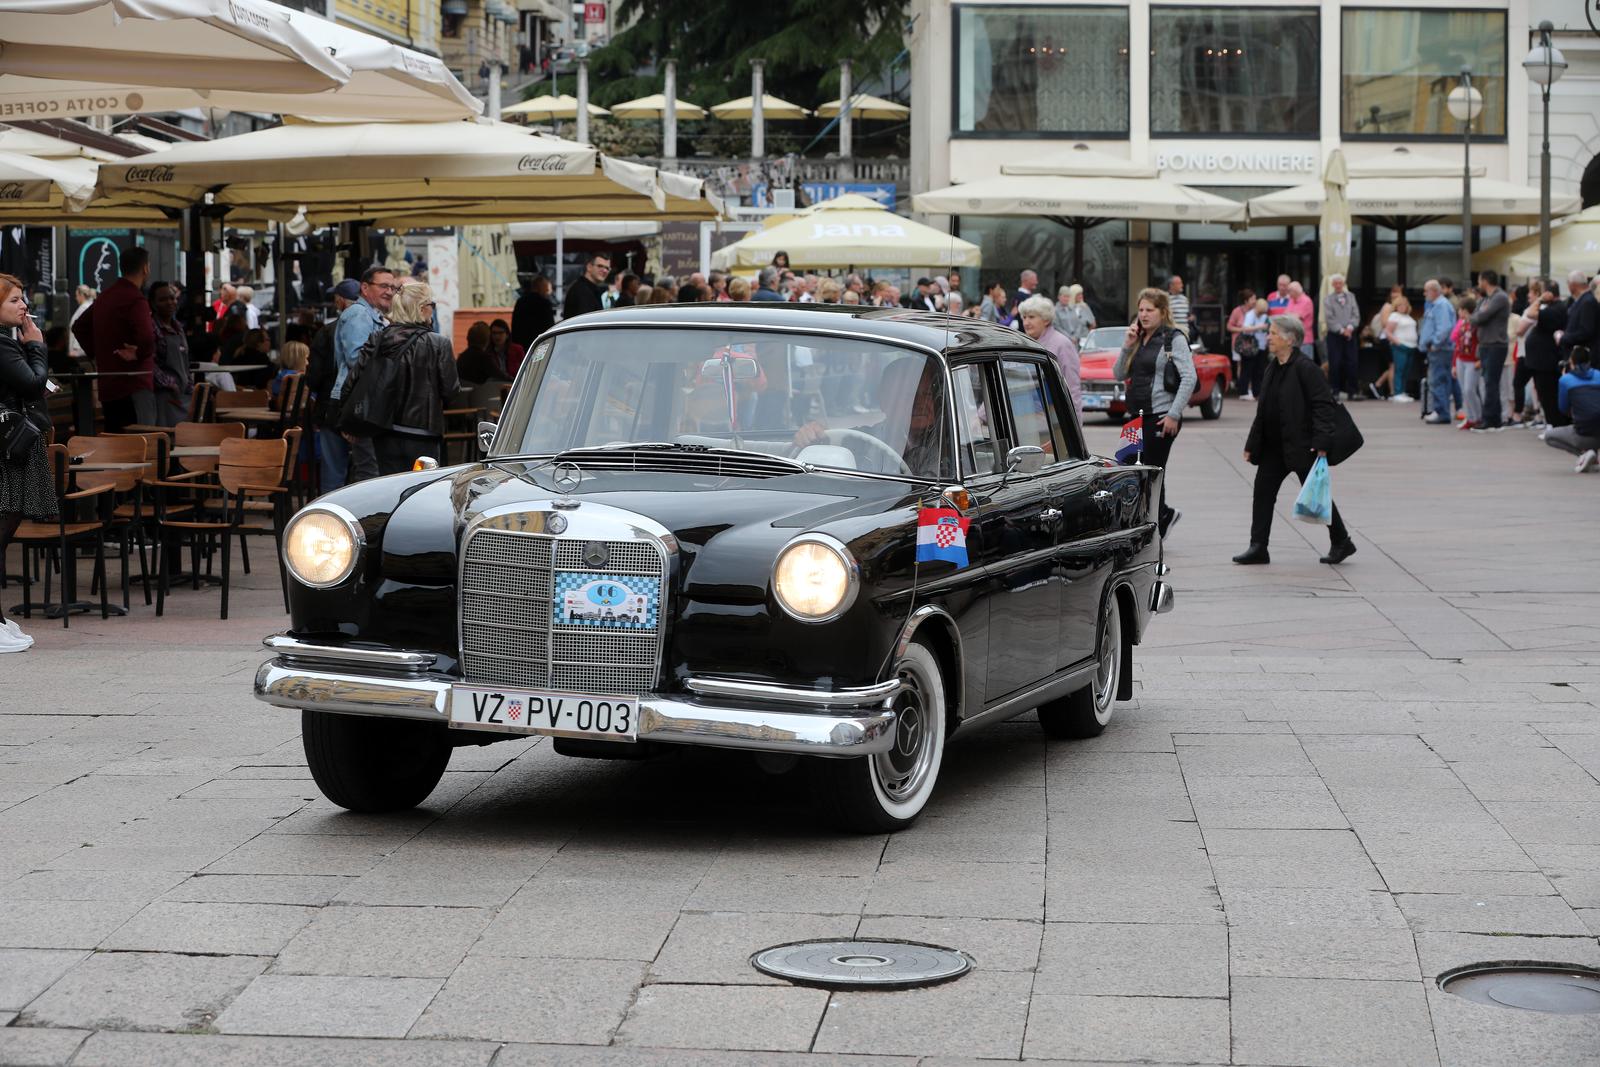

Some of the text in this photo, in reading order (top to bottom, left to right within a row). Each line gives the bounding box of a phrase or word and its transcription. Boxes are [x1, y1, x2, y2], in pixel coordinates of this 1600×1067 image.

[517, 153, 568, 171] Coca-Cola
[1156, 152, 1315, 171] BONBONNIERE
[125, 164, 177, 183] Coca-Cola
[1019, 199, 1046, 209] CHOCO
[1047, 200, 1062, 209] BAR
[1355, 200, 1382, 209] CHOCO
[597, 585, 618, 598] 66
[527, 696, 631, 734] PV-003
